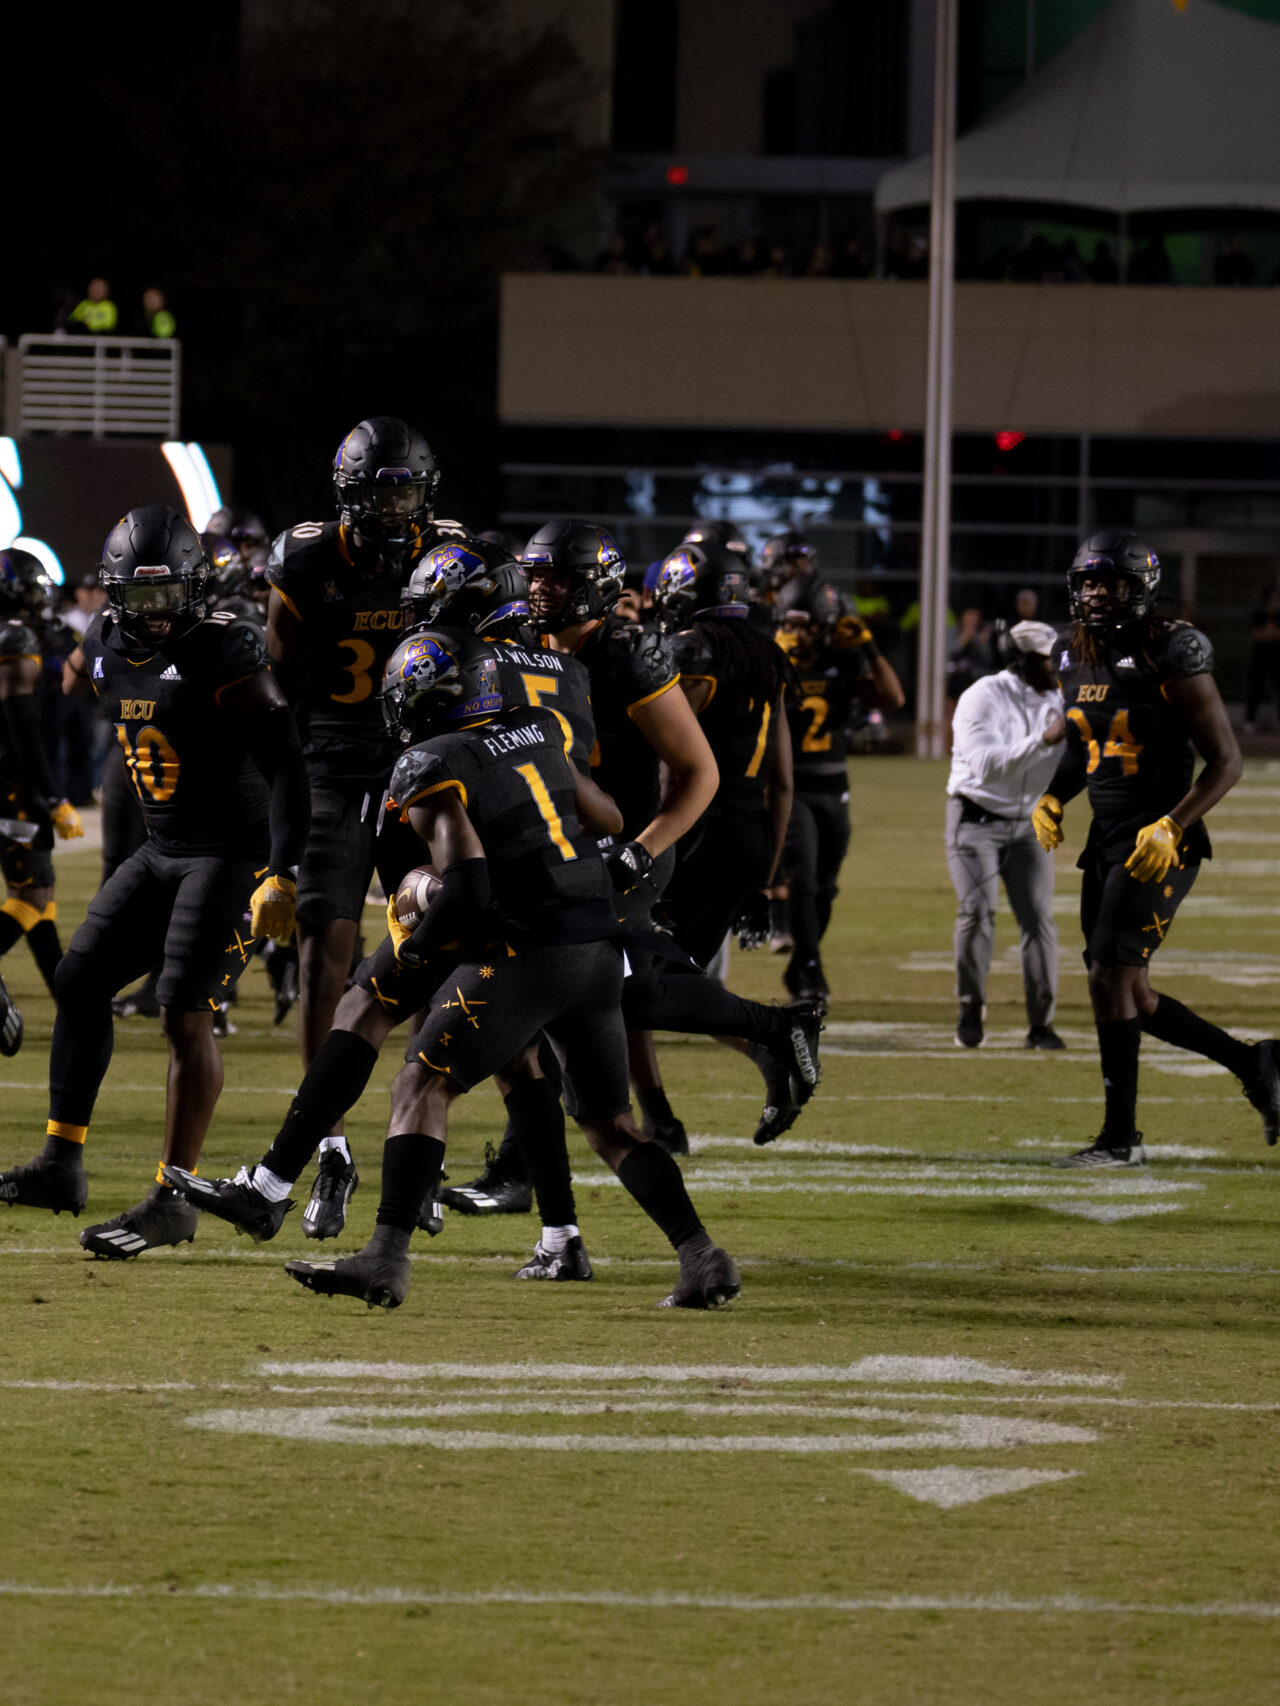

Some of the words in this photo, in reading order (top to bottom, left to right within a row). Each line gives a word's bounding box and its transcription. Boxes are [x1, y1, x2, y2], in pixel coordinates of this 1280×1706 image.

[437, 549, 456, 564] ECU
[352, 610, 403, 631] ECU
[411, 643, 431, 657] ECU
[510, 650, 564, 672] WILSON
[330, 638, 388, 703] 3
[1076, 684, 1110, 703] ECU
[120, 699, 156, 720] ECU
[521, 672, 573, 764] 5
[483, 724, 545, 756] FLEMING
[113, 723, 180, 802] 10
[512, 761, 578, 862] 1
